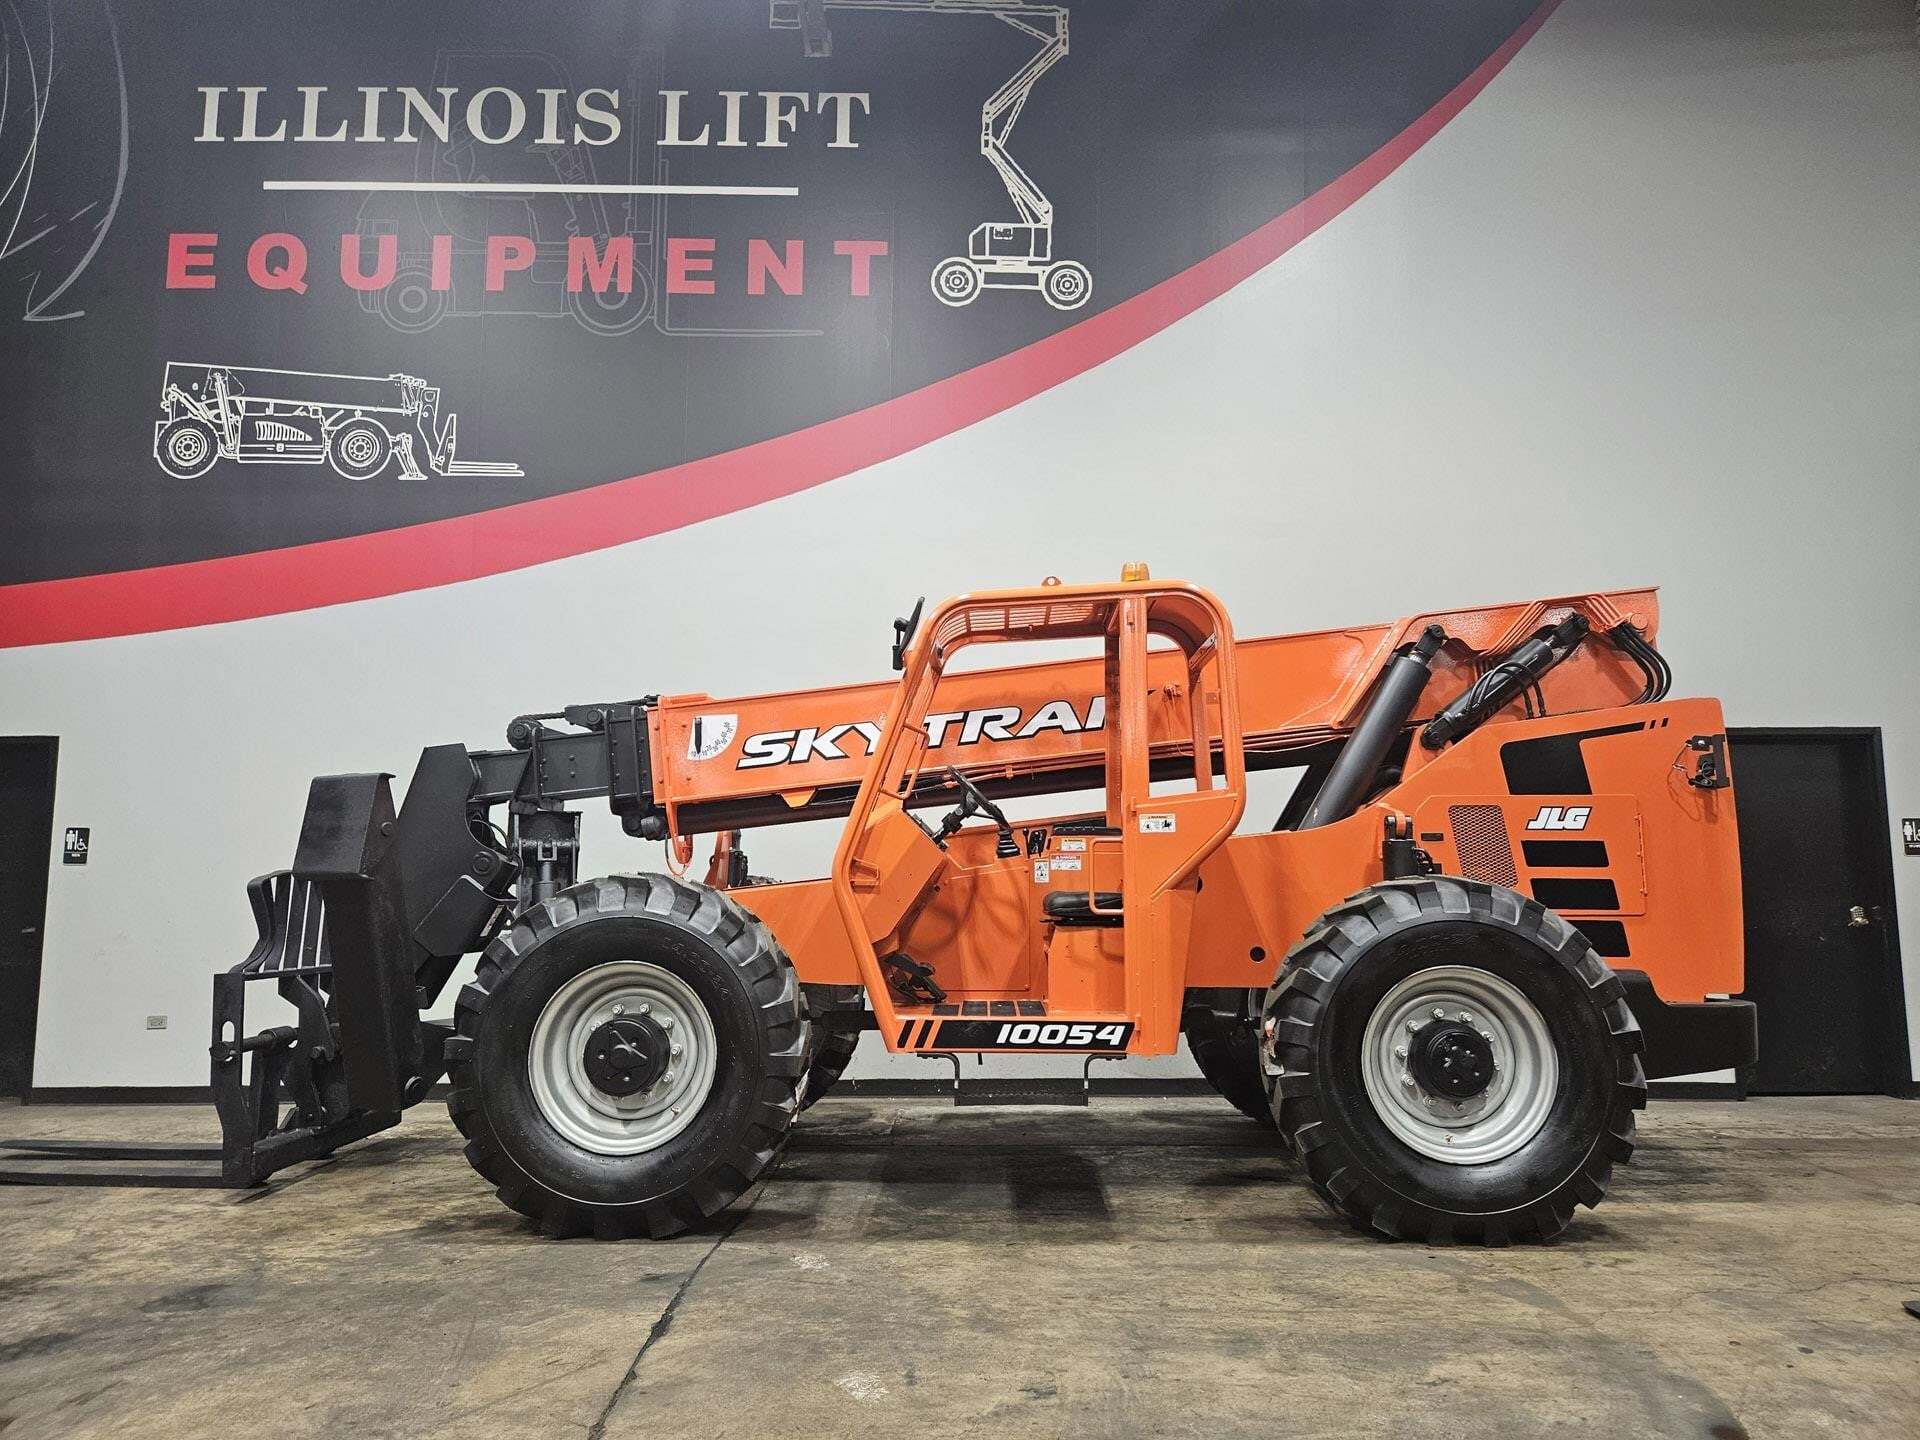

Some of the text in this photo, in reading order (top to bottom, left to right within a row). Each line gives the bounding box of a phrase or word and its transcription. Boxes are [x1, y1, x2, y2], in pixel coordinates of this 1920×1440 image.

[193, 86, 871, 148] ILLINOIS LIFT
[165, 231, 889, 297] EQUIPMENT
[1526, 806, 1592, 830] JLG
[995, 1022, 1127, 1047] 10054
